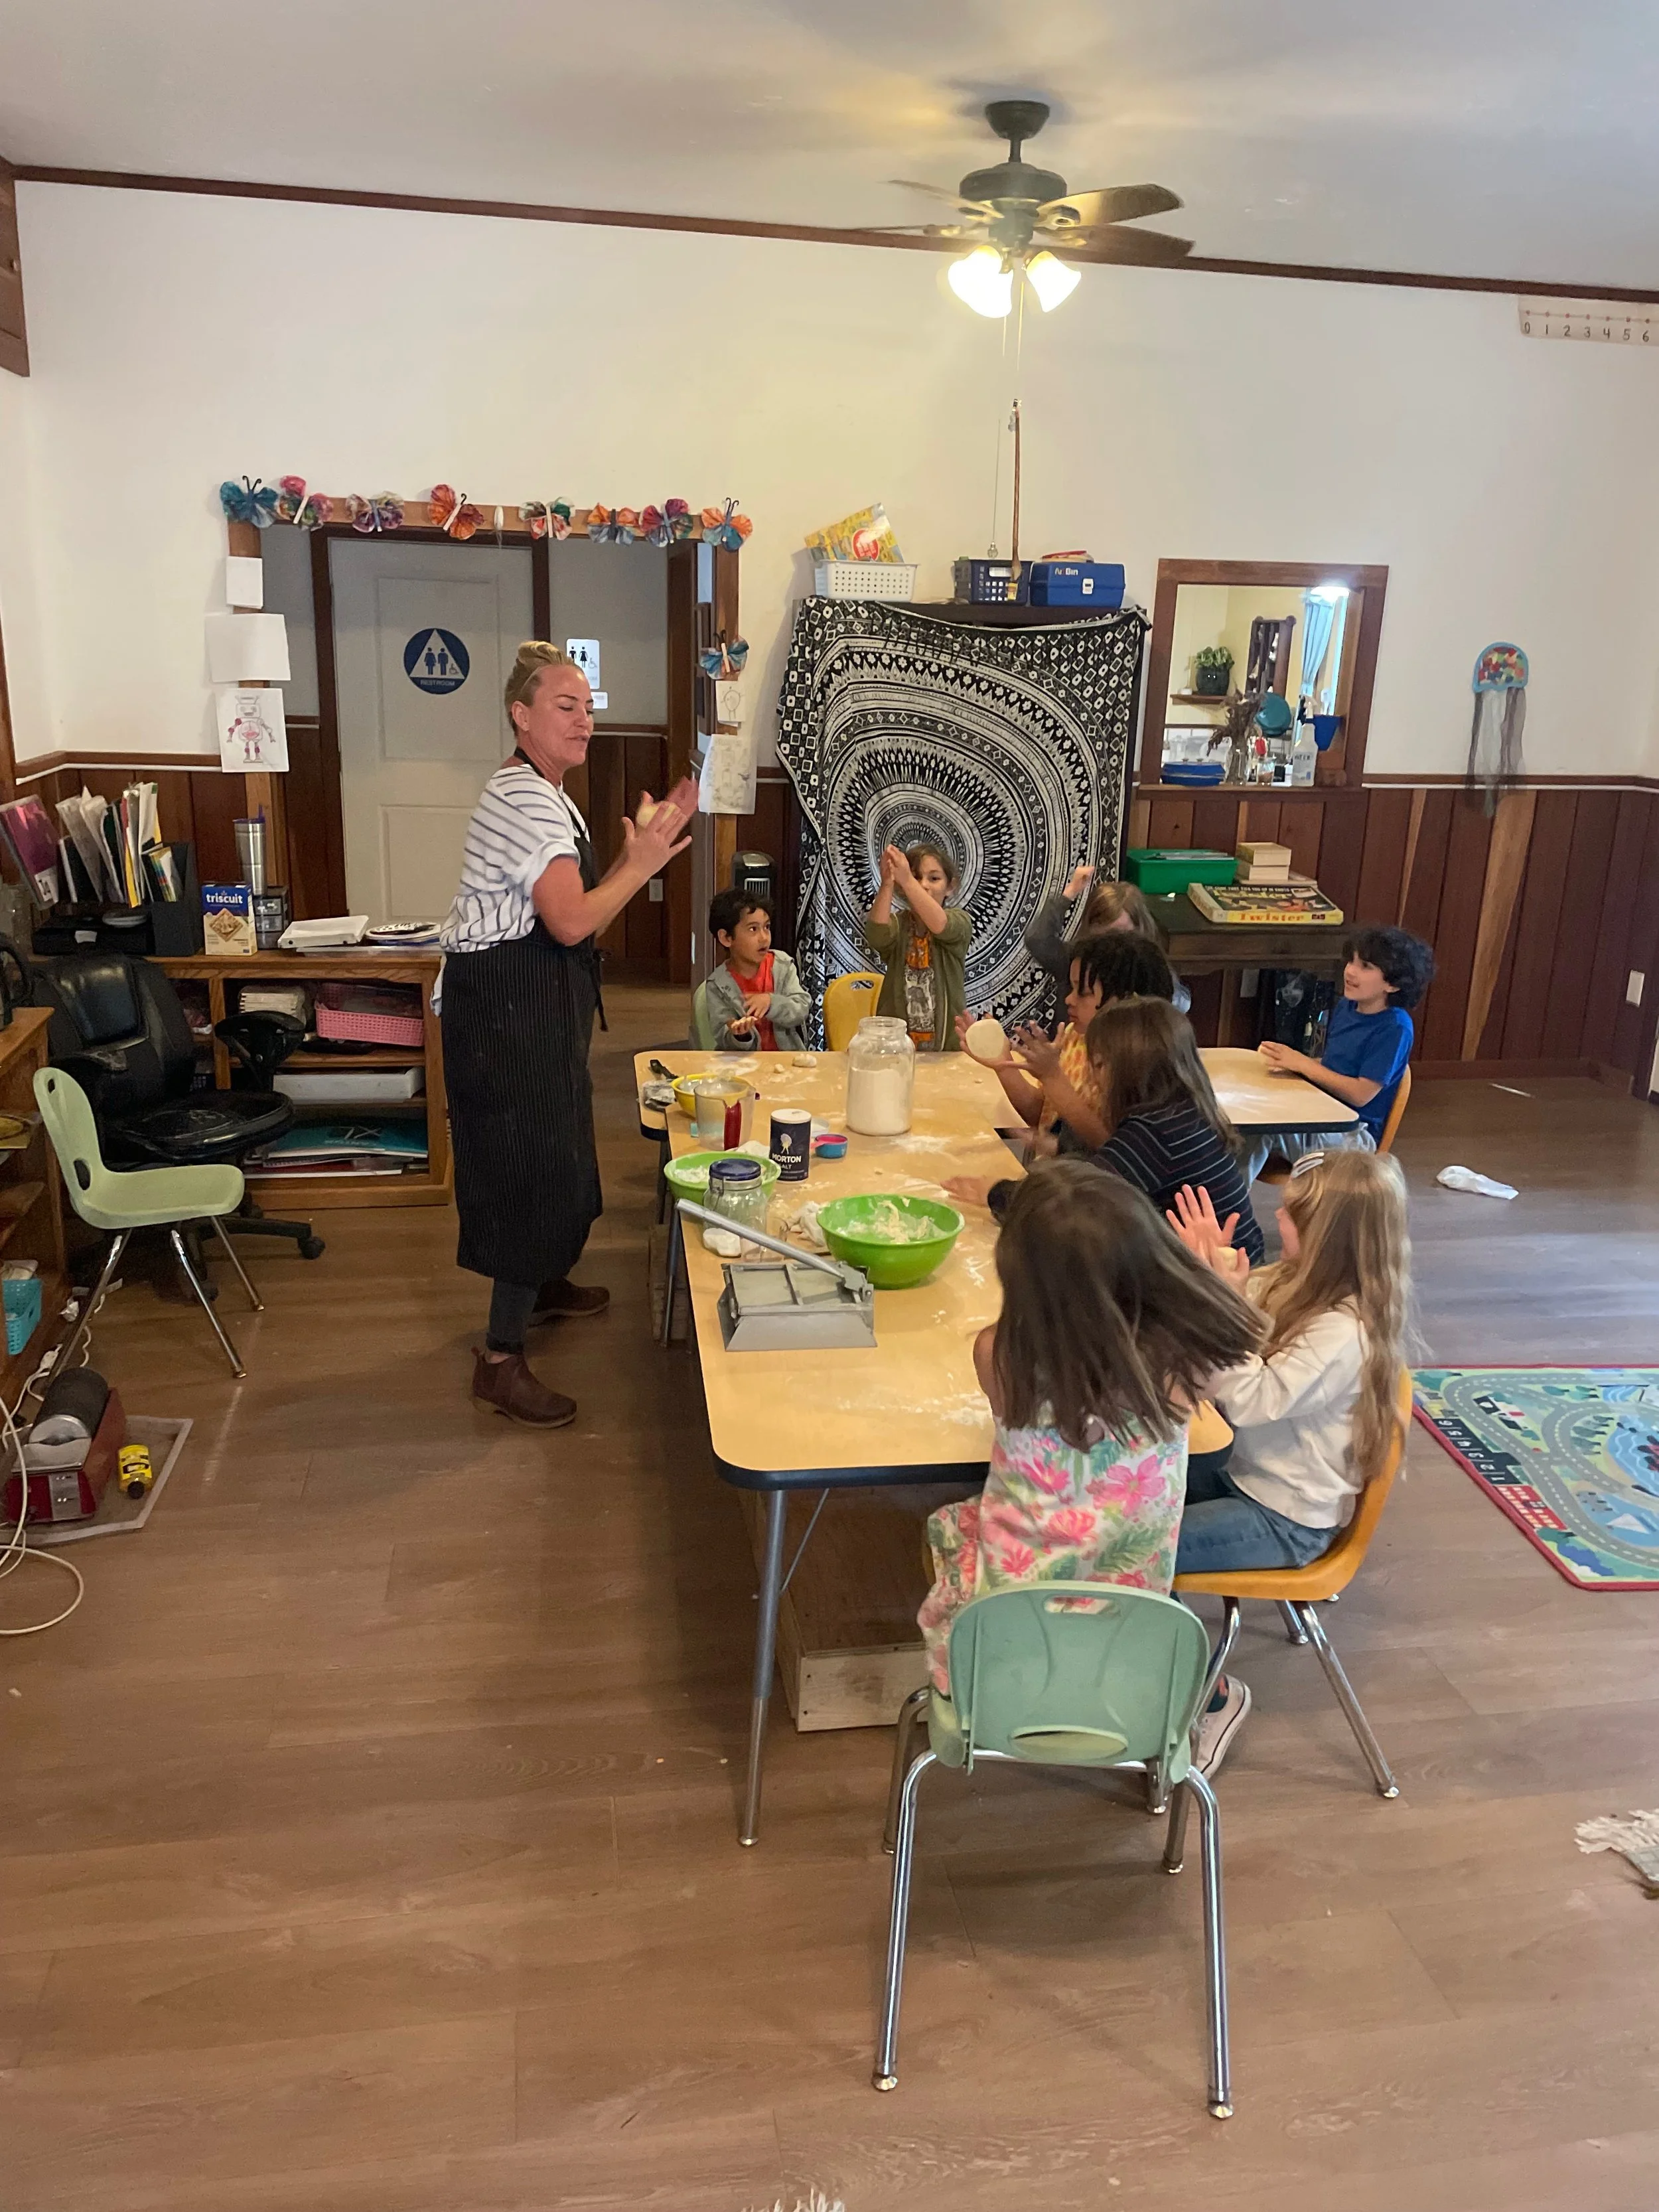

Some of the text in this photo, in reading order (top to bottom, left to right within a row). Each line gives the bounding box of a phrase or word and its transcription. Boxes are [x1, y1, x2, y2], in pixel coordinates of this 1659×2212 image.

[1524, 321, 1650, 342] 0 1 2 3 4 5 6
[206, 893, 244, 904] triscuit
[1240, 913, 1305, 921] Twister
[772, 1153, 802, 1163] MORTON
